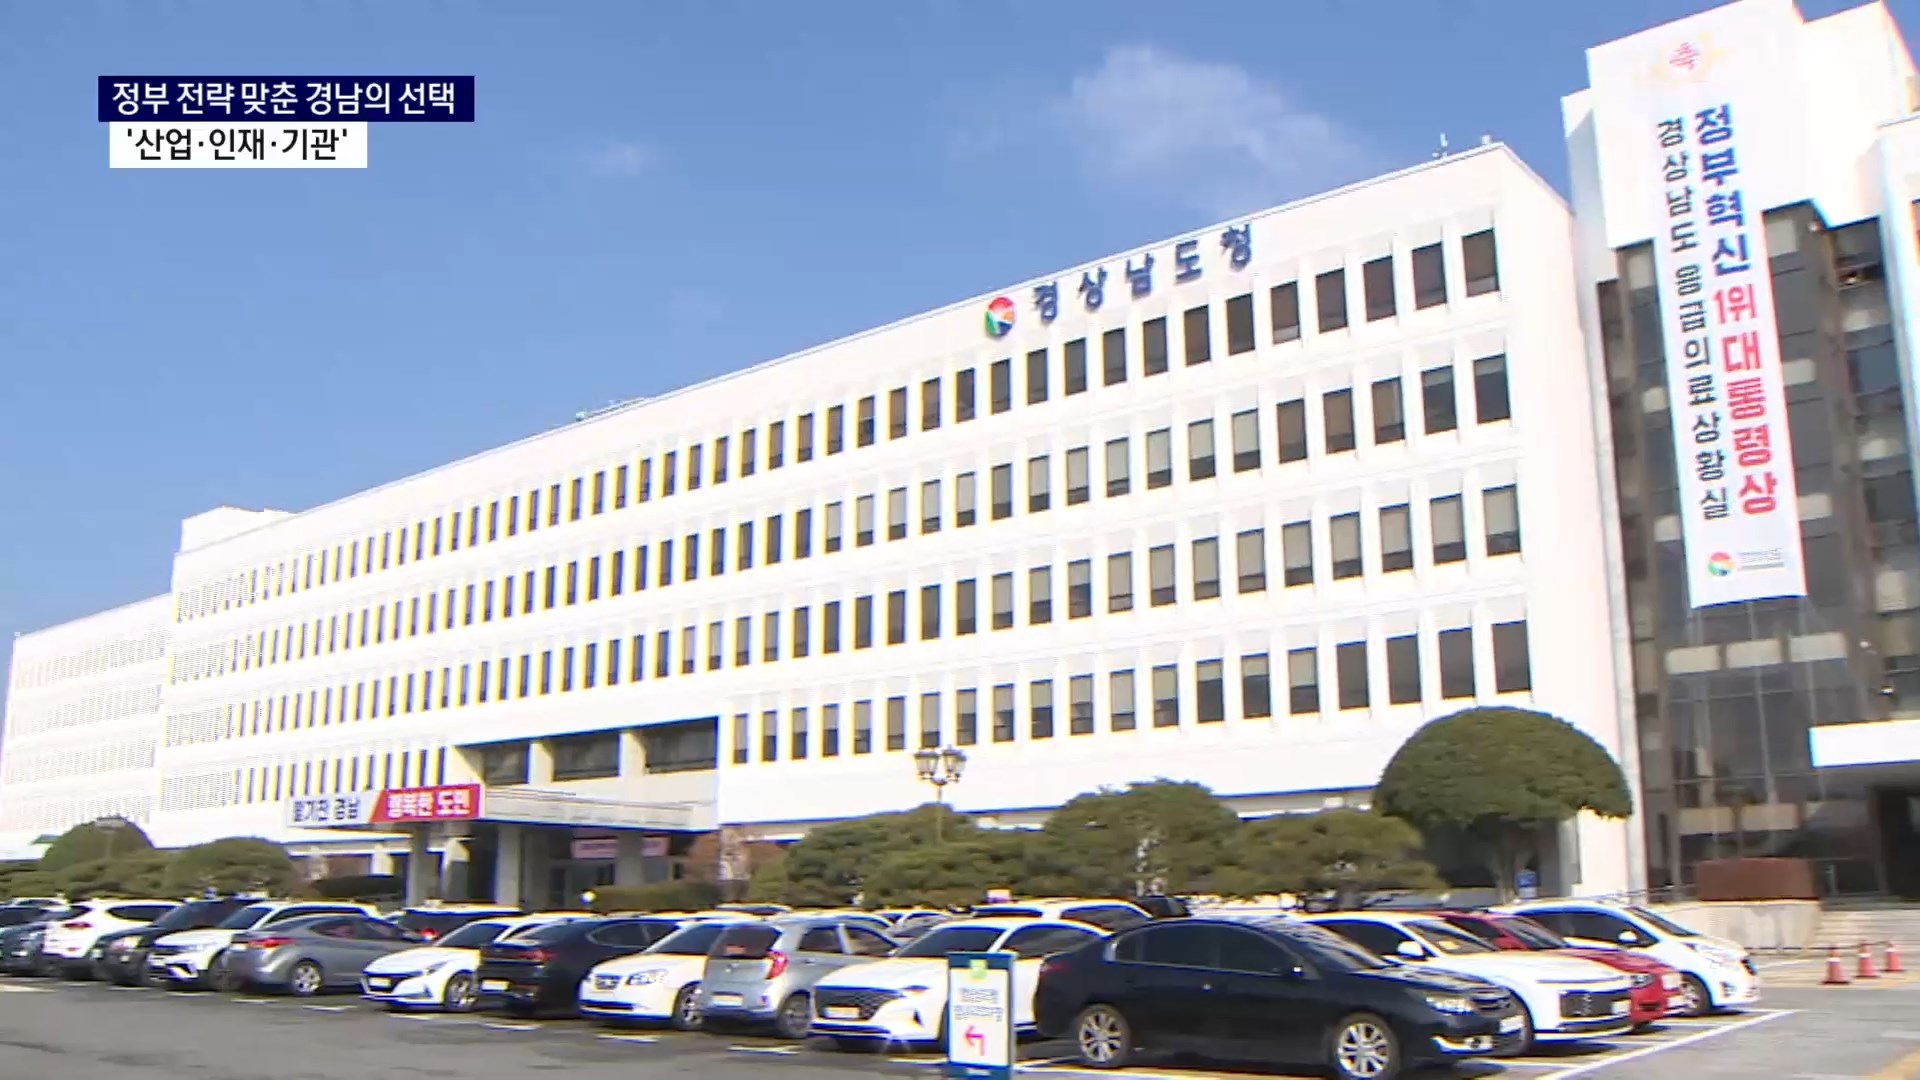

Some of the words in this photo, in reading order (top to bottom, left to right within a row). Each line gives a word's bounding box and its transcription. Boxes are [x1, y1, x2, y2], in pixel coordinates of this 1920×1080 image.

[1657, 117, 1699, 253] 경상남도
[1695, 104, 1751, 277] 정부혁신
[1032, 224, 1252, 323] 경상남도청
[1721, 331, 1779, 515] 대통령상
